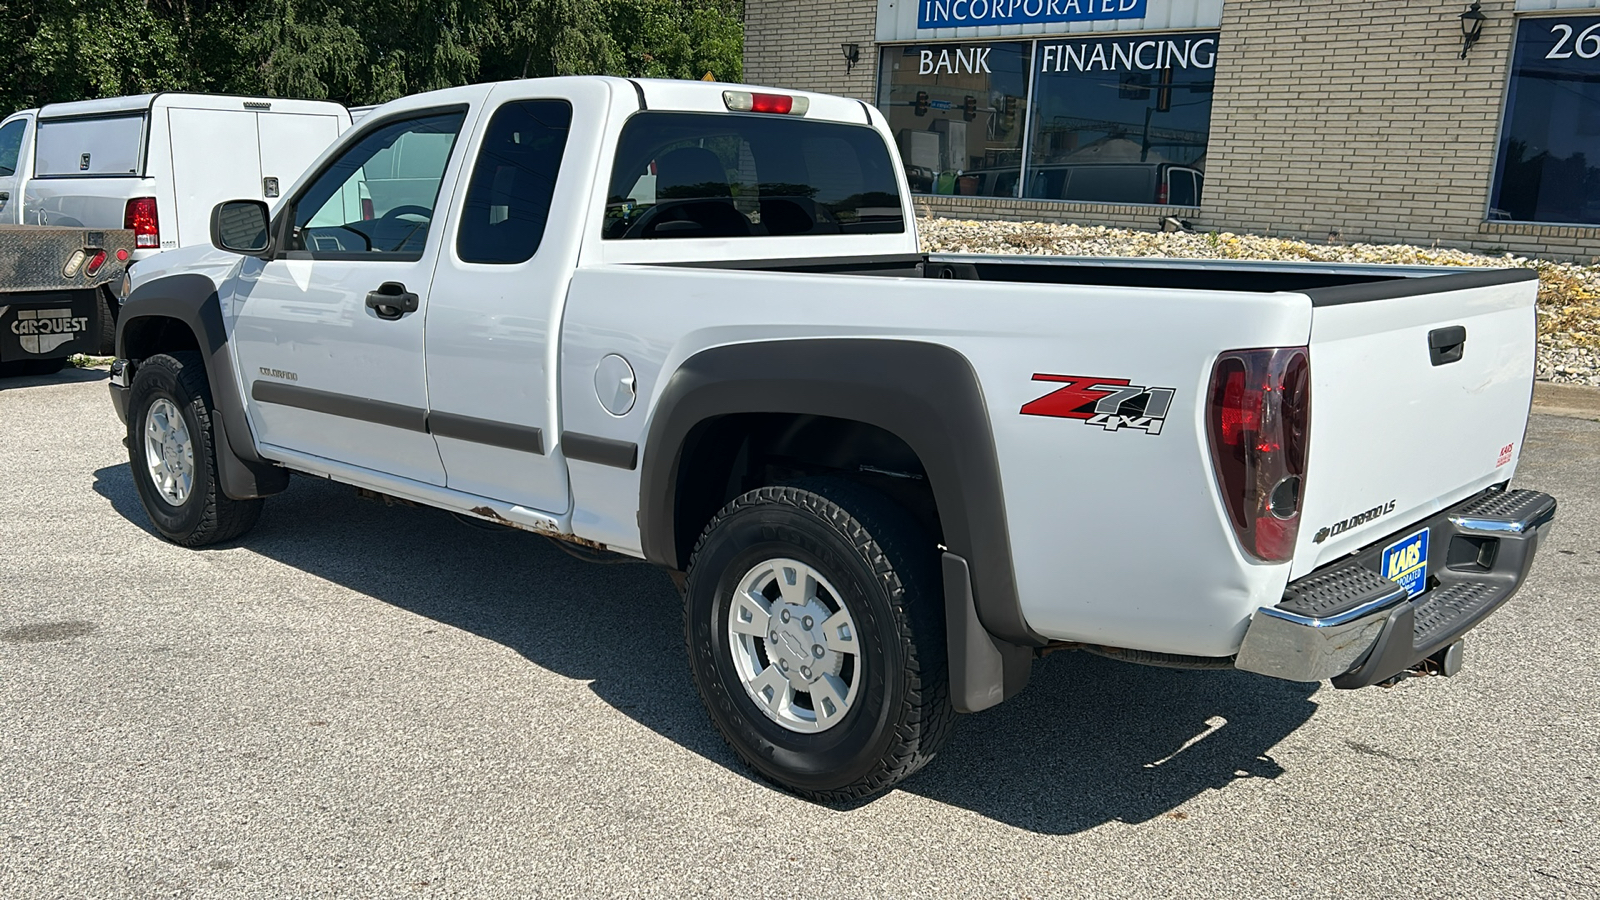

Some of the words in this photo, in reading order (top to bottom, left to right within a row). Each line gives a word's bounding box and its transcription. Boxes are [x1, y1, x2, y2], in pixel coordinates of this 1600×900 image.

[925, 0, 1138, 22] INCORPORATED
[918, 47, 992, 75] BANK
[1041, 38, 1215, 73] FINANCING
[10, 317, 88, 335] CARQUEST
[259, 366, 299, 381] COLORADO
[1019, 373, 1177, 419] Z71
[1330, 504, 1383, 538] COLORADO
[1383, 499, 1396, 515] LS
[1388, 540, 1422, 579] KARS
